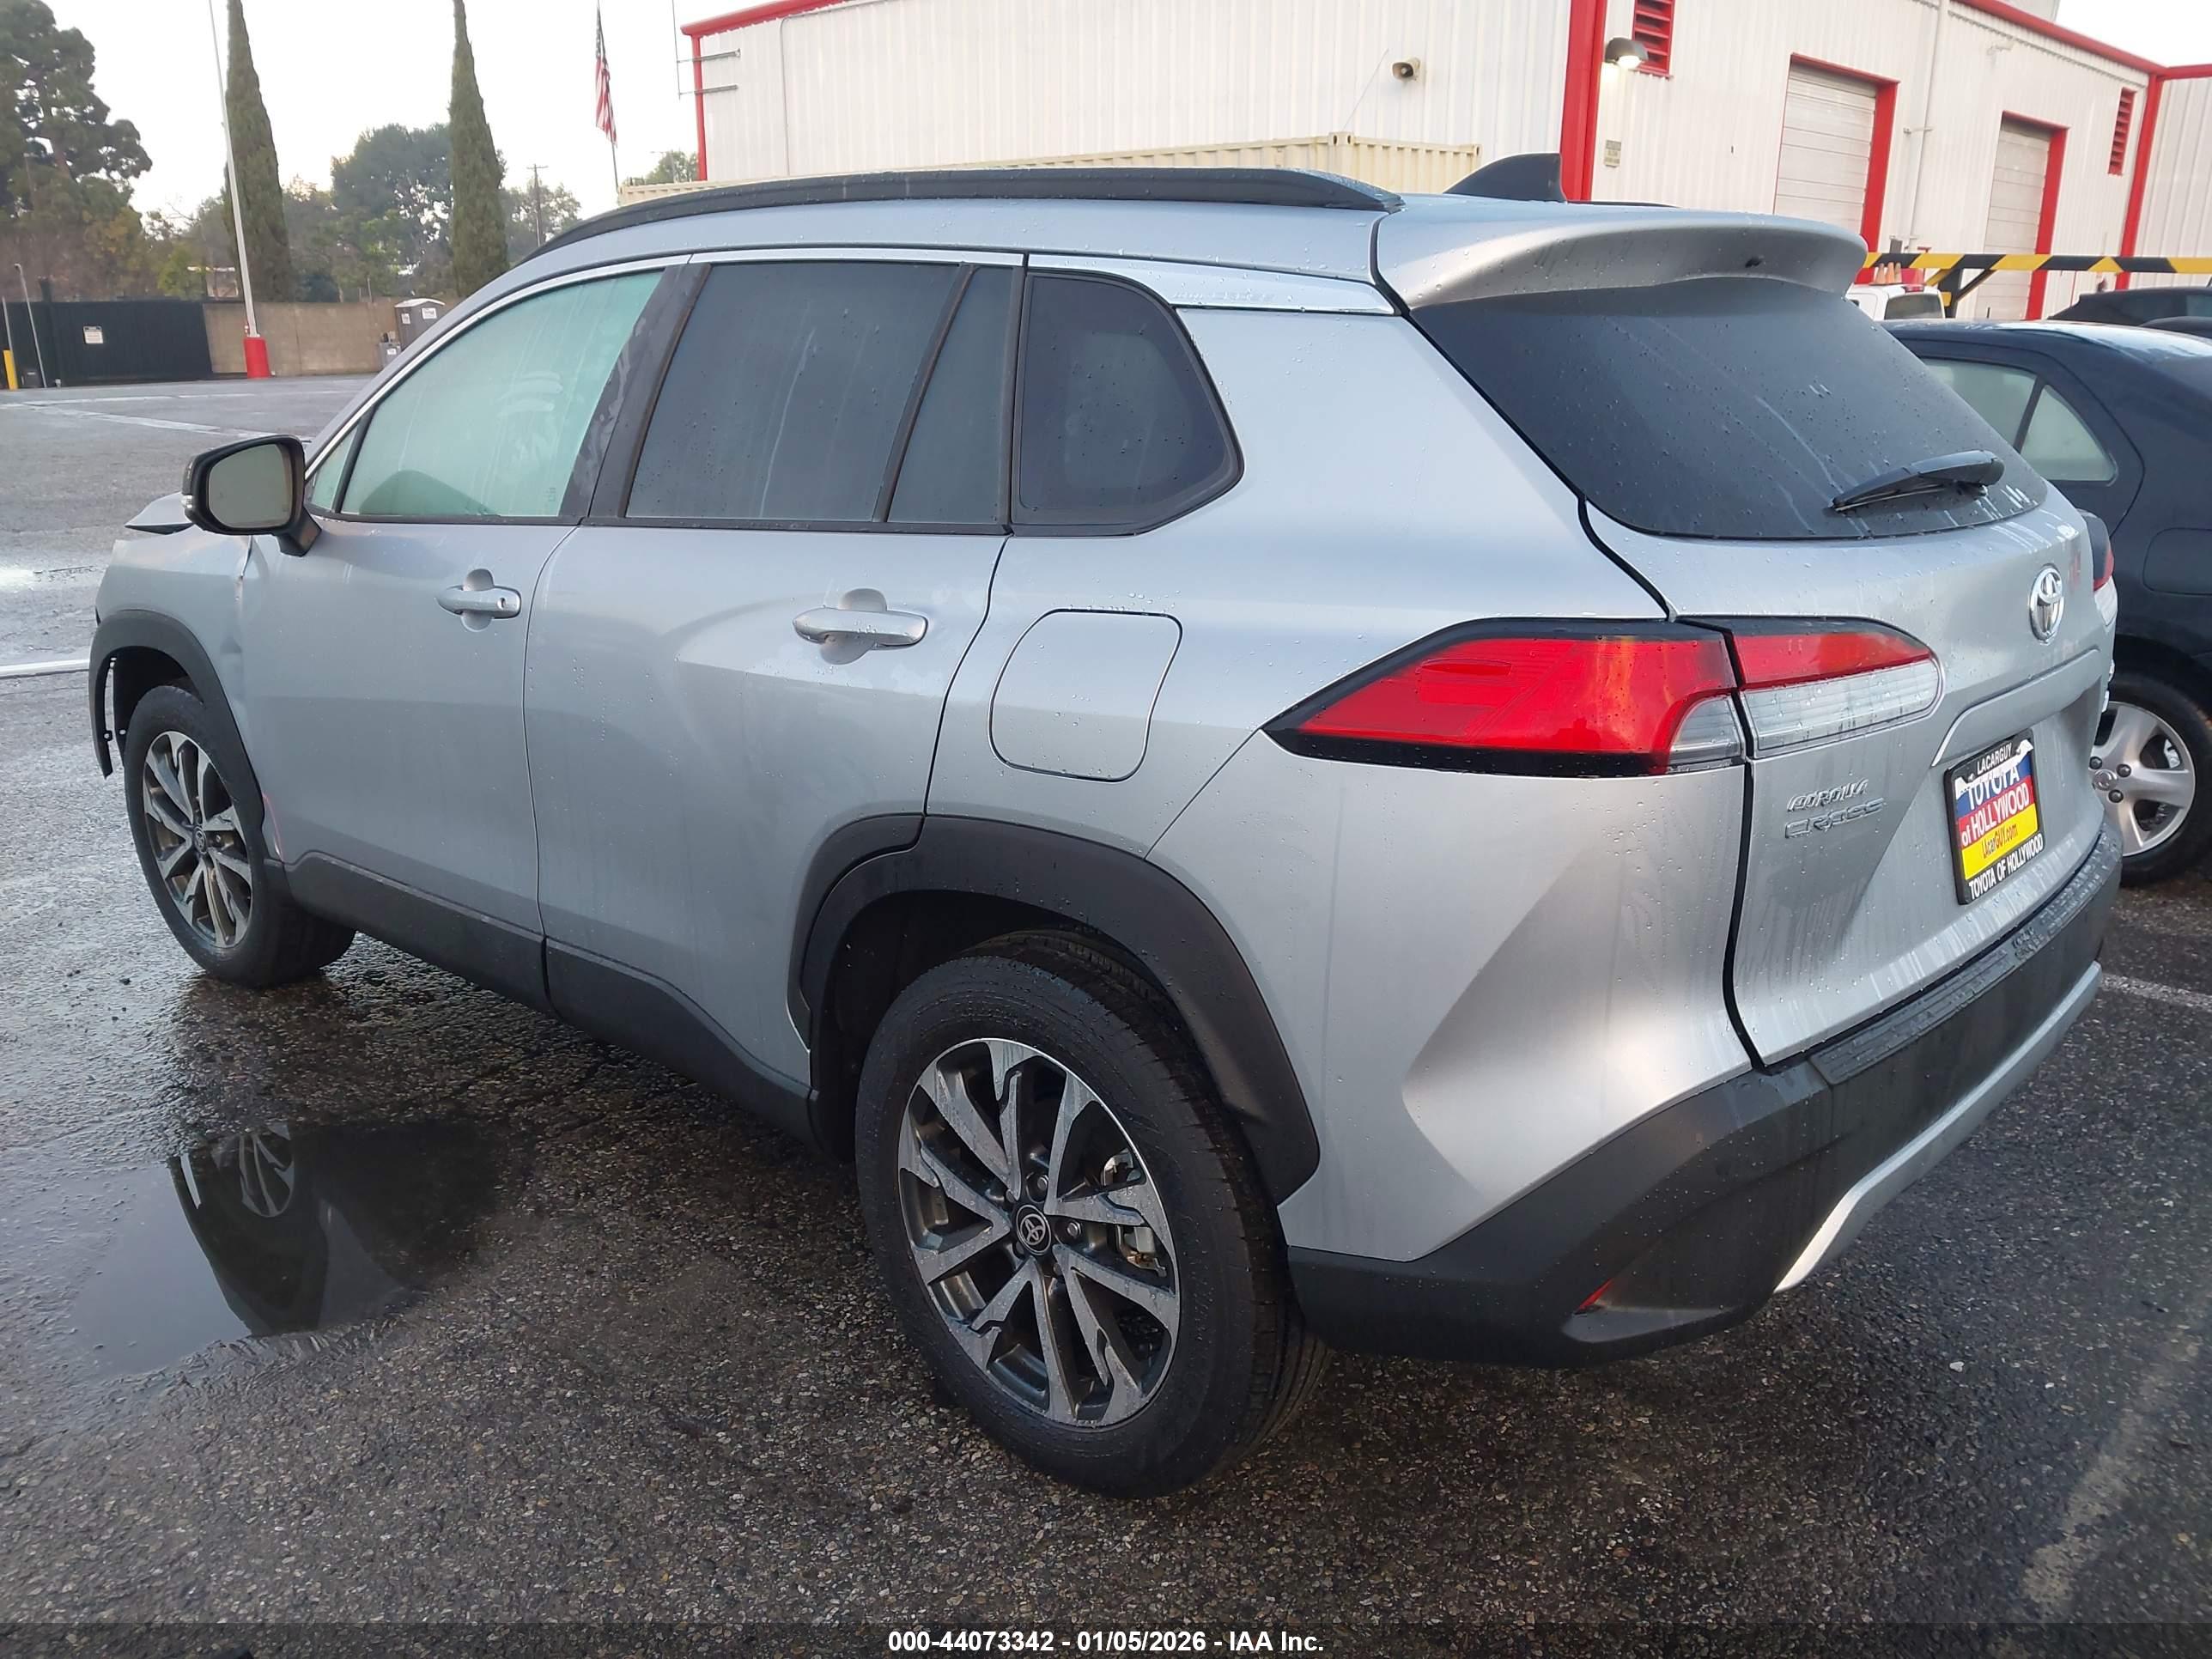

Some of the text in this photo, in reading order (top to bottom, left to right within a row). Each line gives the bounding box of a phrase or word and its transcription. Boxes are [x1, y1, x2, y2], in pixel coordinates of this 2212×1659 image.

[1977, 742, 2013, 775] LACARGUY
[1961, 782, 2030, 847] of HOLLYWOOD
[1966, 764, 2020, 811] TOYOTA
[1969, 833, 2044, 900] TOYOTA OF HOLLYWOOD
